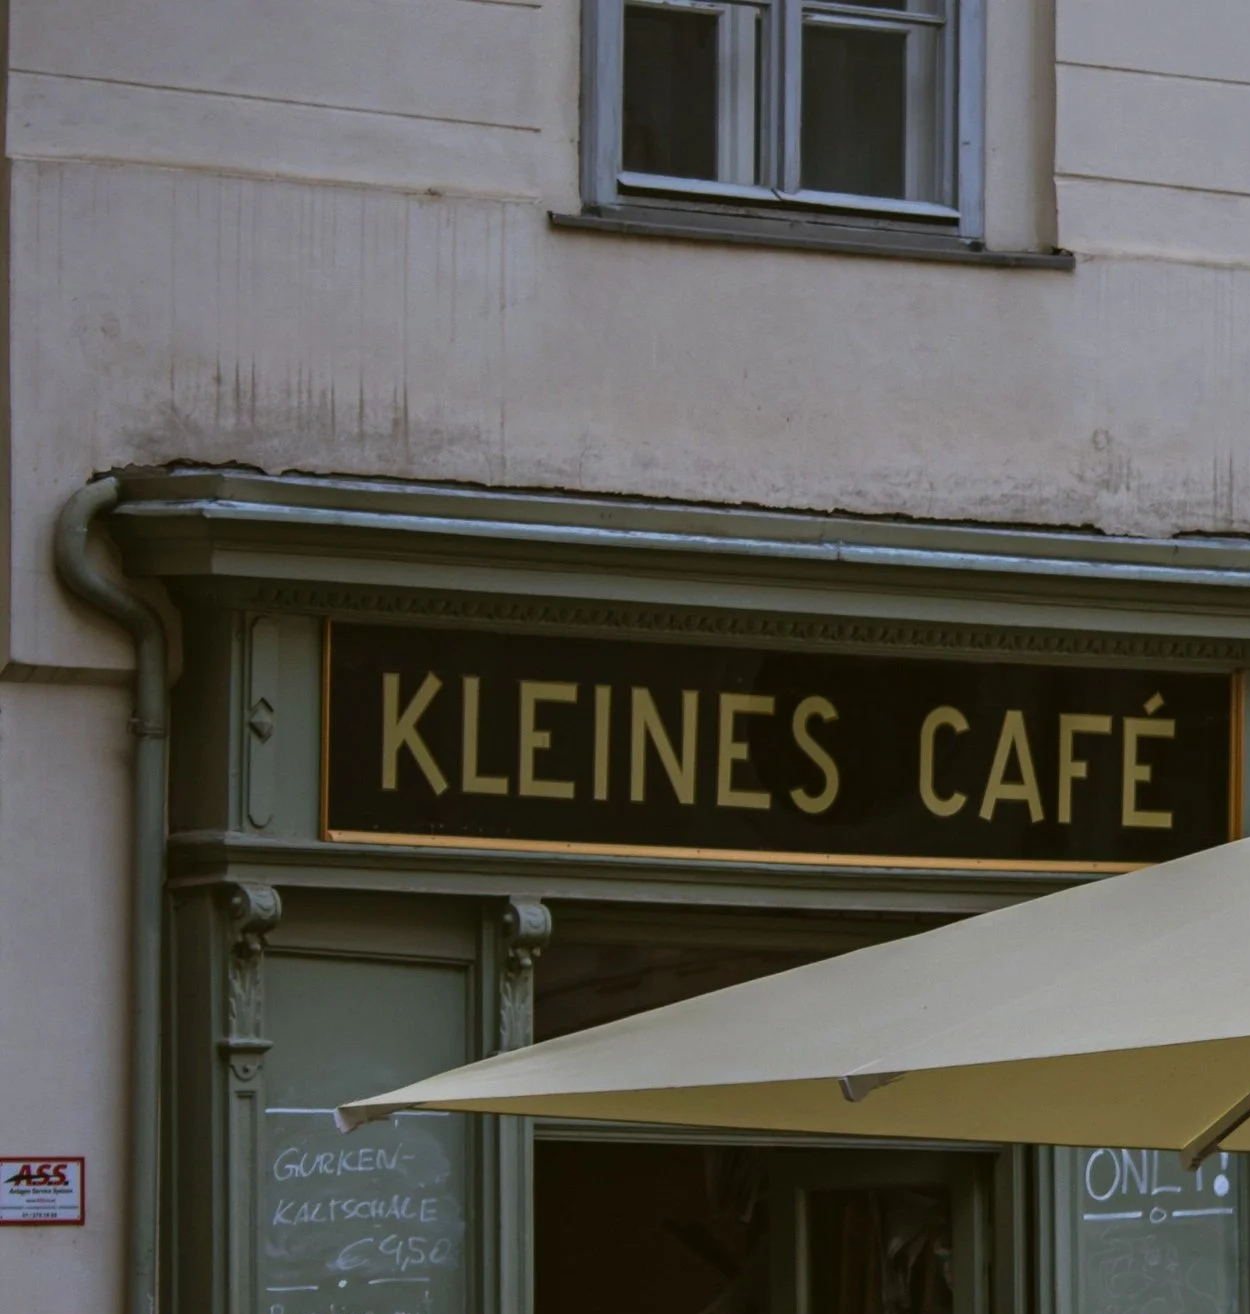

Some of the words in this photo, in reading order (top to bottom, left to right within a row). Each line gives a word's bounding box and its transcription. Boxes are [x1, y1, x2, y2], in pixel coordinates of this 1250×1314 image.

[382, 671, 840, 815] KLEINES
[919, 692, 1176, 829] CAFÉ
[1085, 1149, 1230, 1202] ONL!
[273, 1195, 439, 1226] KALTSCHALE
